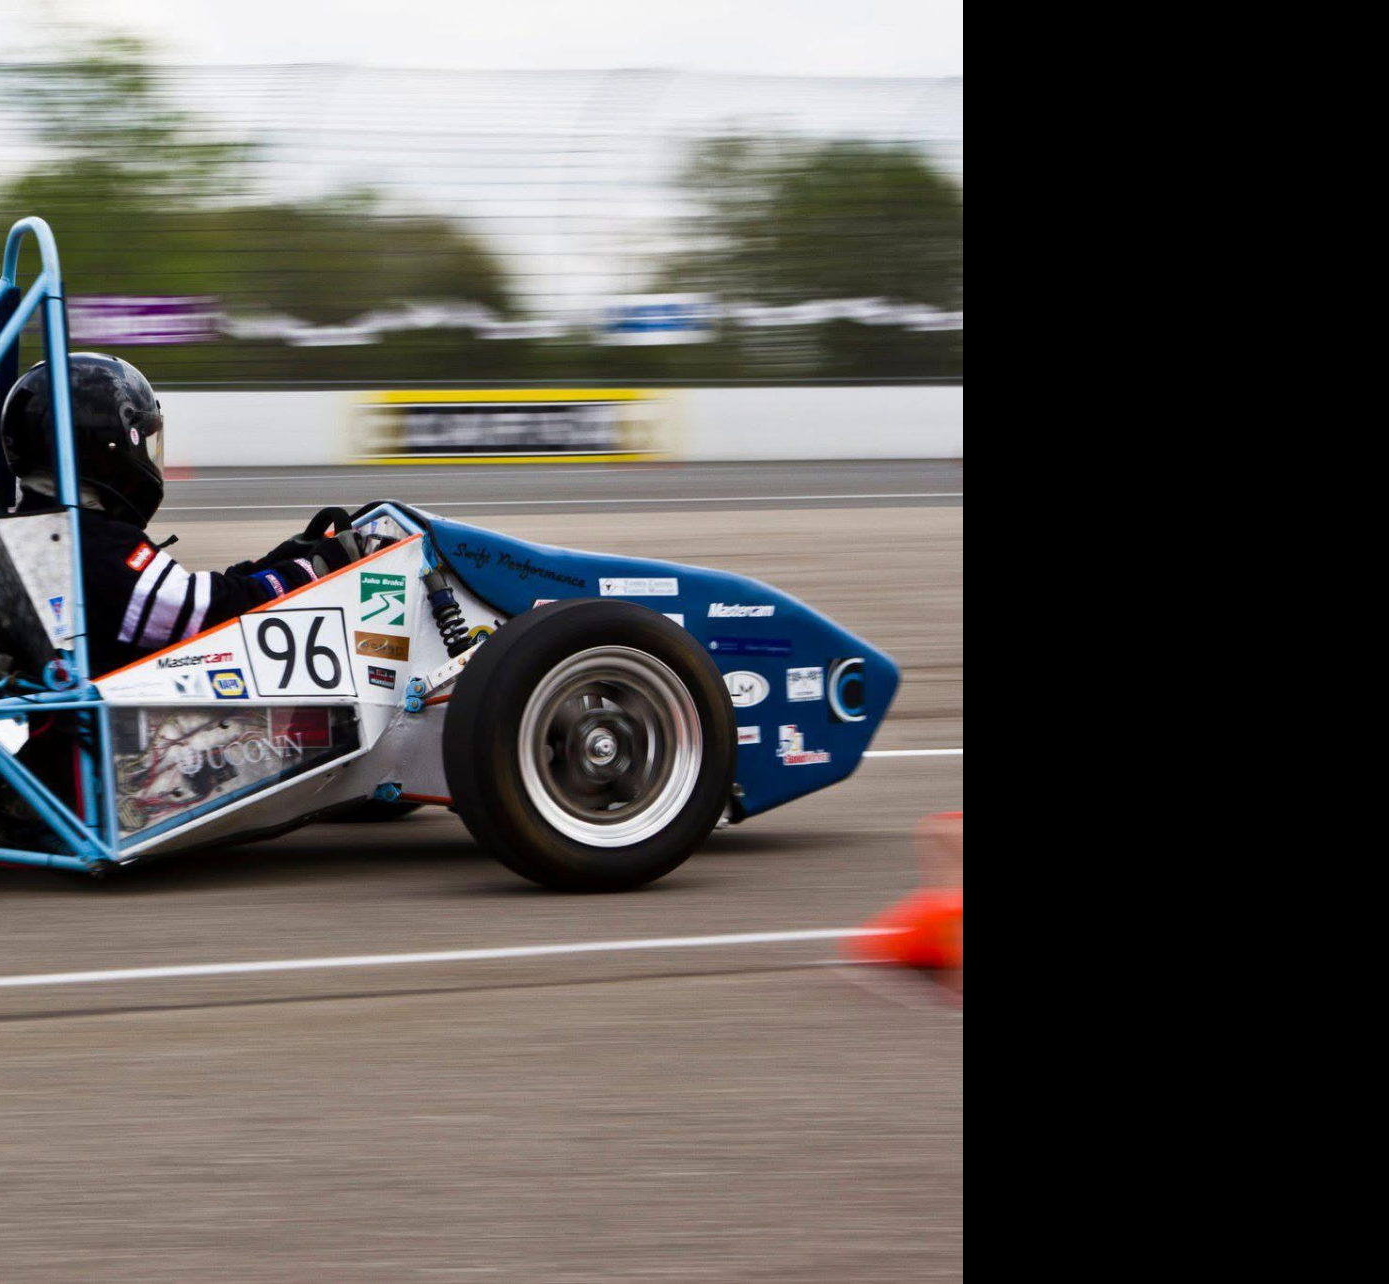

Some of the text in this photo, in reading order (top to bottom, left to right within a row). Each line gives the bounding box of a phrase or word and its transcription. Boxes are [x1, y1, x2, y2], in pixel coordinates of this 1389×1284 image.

[453, 543, 587, 588] Swift Performance
[361, 577, 381, 585] Jake
[707, 602, 776, 618] Mastercam
[155, 652, 233, 669] Mastercam
[256, 616, 342, 690] 96
[207, 732, 303, 769] UCONN
